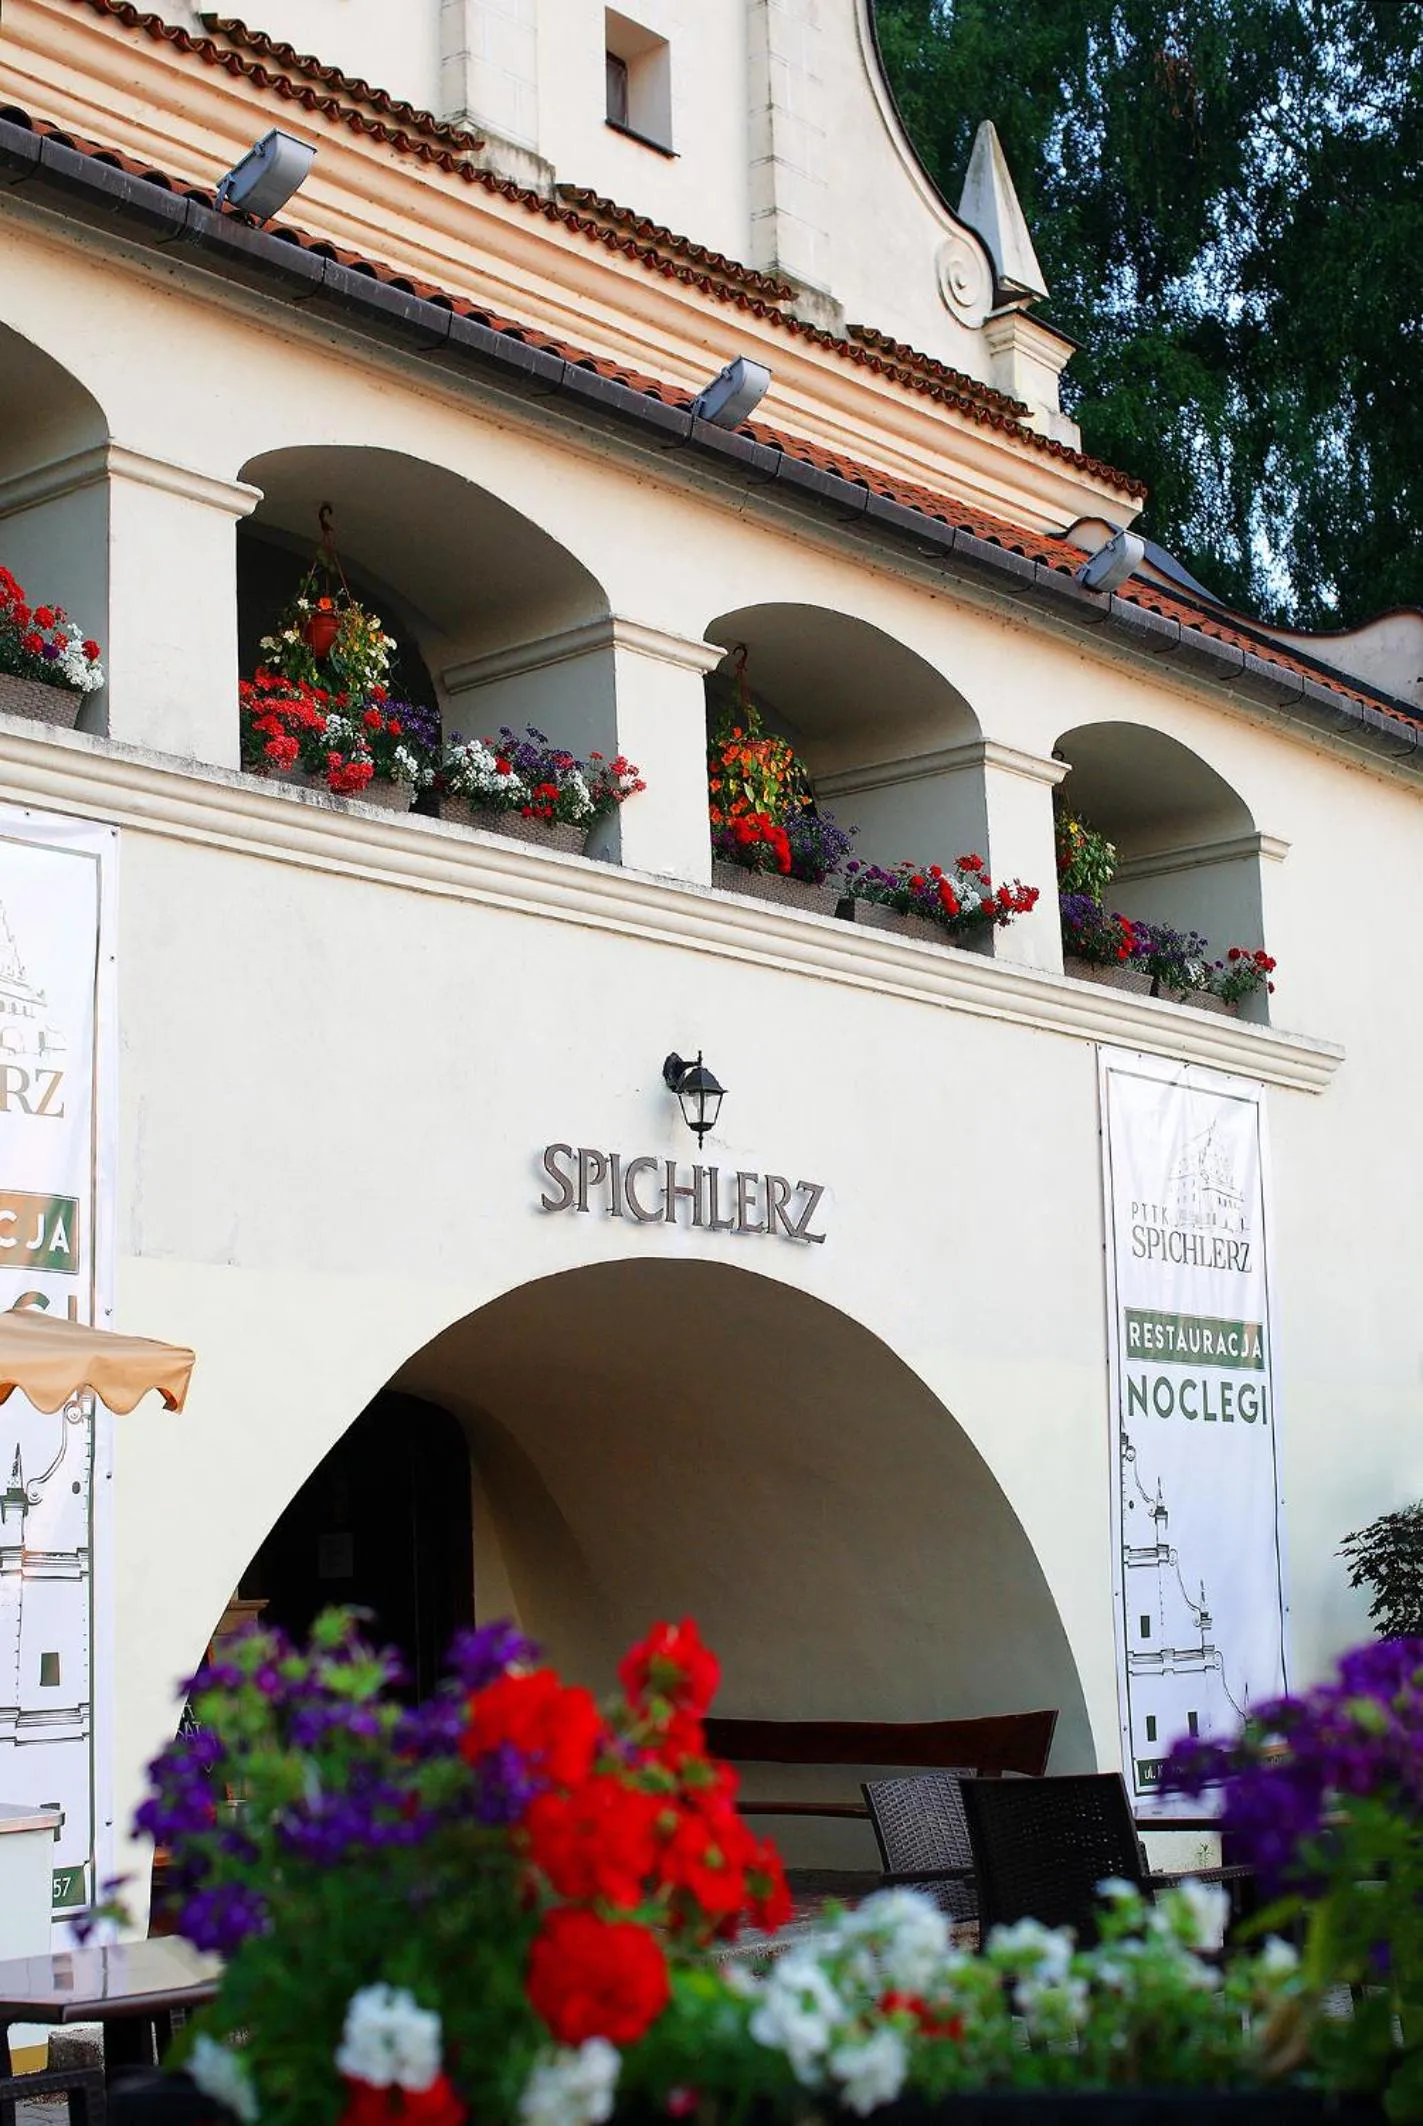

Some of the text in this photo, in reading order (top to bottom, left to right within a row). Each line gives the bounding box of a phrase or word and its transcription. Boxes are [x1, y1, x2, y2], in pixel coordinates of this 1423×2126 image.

[541, 1143, 828, 1244] SPICHLERZ
[1131, 1201, 1169, 1225] PTTK
[1131, 1224, 1253, 1273] SPICHLERZ
[1129, 1321, 1263, 1359] RESTAURACJA
[1127, 1374, 1268, 1425] NOCLEGI
[53, 1877, 71, 1898] 57
